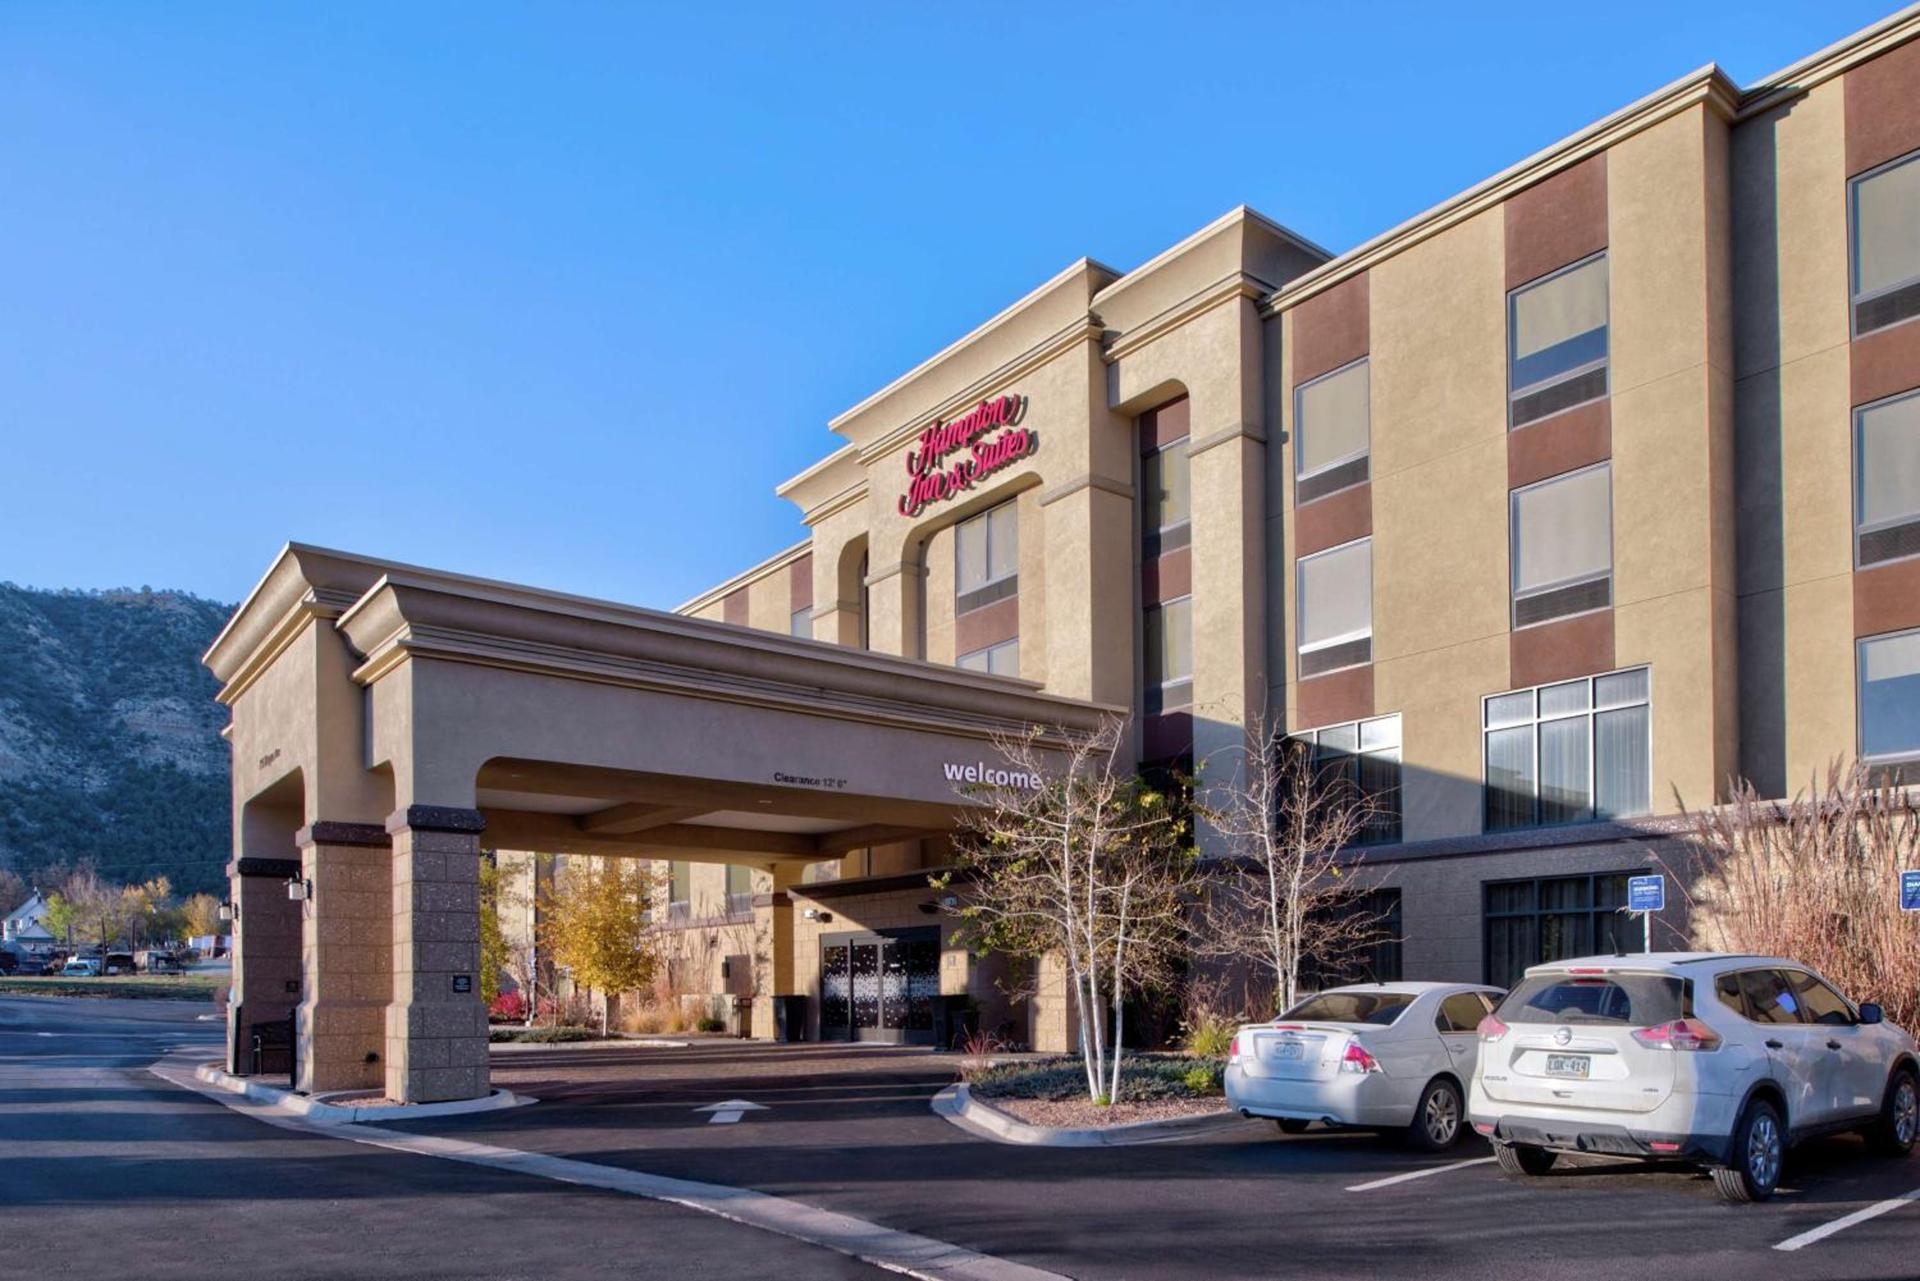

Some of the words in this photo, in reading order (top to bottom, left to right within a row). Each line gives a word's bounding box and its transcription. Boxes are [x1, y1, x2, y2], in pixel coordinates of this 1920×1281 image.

[906, 394, 1023, 476] Hampton
[898, 471, 951, 517] Inn
[949, 463, 967, 491] &
[964, 428, 1031, 481] Suites
[774, 771, 820, 786] Clearance
[943, 761, 1041, 790] welcome
